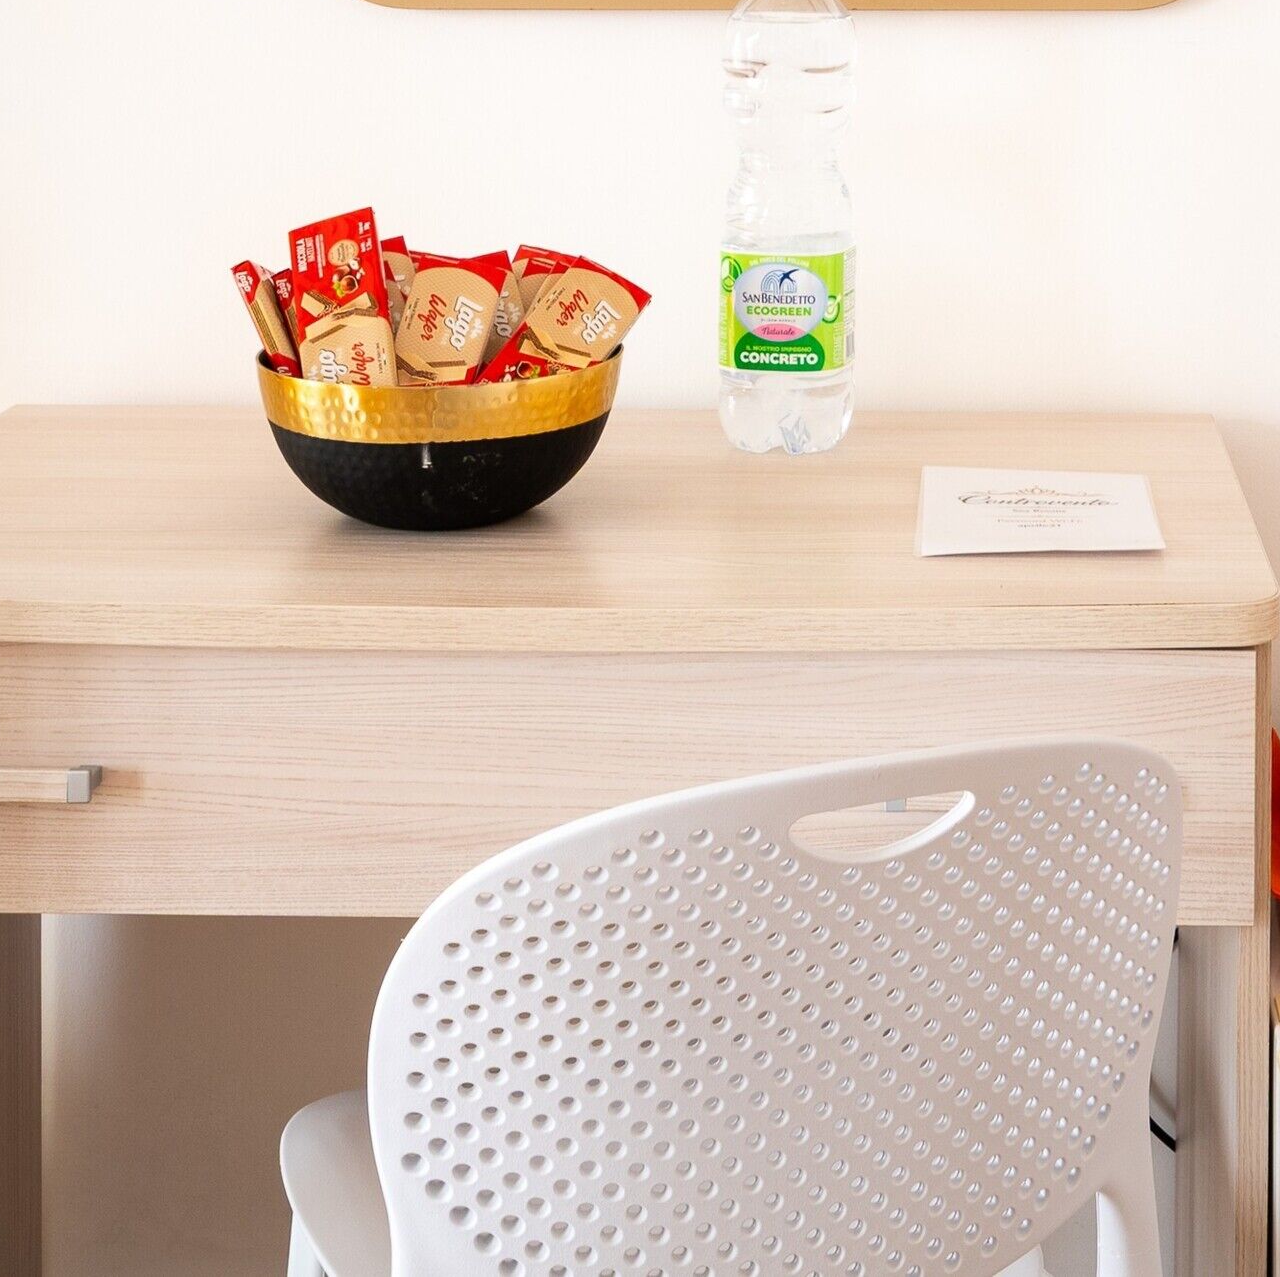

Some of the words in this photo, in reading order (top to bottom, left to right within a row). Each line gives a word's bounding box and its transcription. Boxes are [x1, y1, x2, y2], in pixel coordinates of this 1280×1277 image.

[418, 293, 448, 342] Wafer
[444, 295, 484, 352] Lago
[556, 289, 590, 328] Wafer
[580, 299, 622, 345] Lago
[746, 305, 812, 317] ECOGREEN
[761, 327, 796, 336] Naturale
[349, 342, 375, 386] Wafer
[740, 351, 819, 365] CONCRETO
